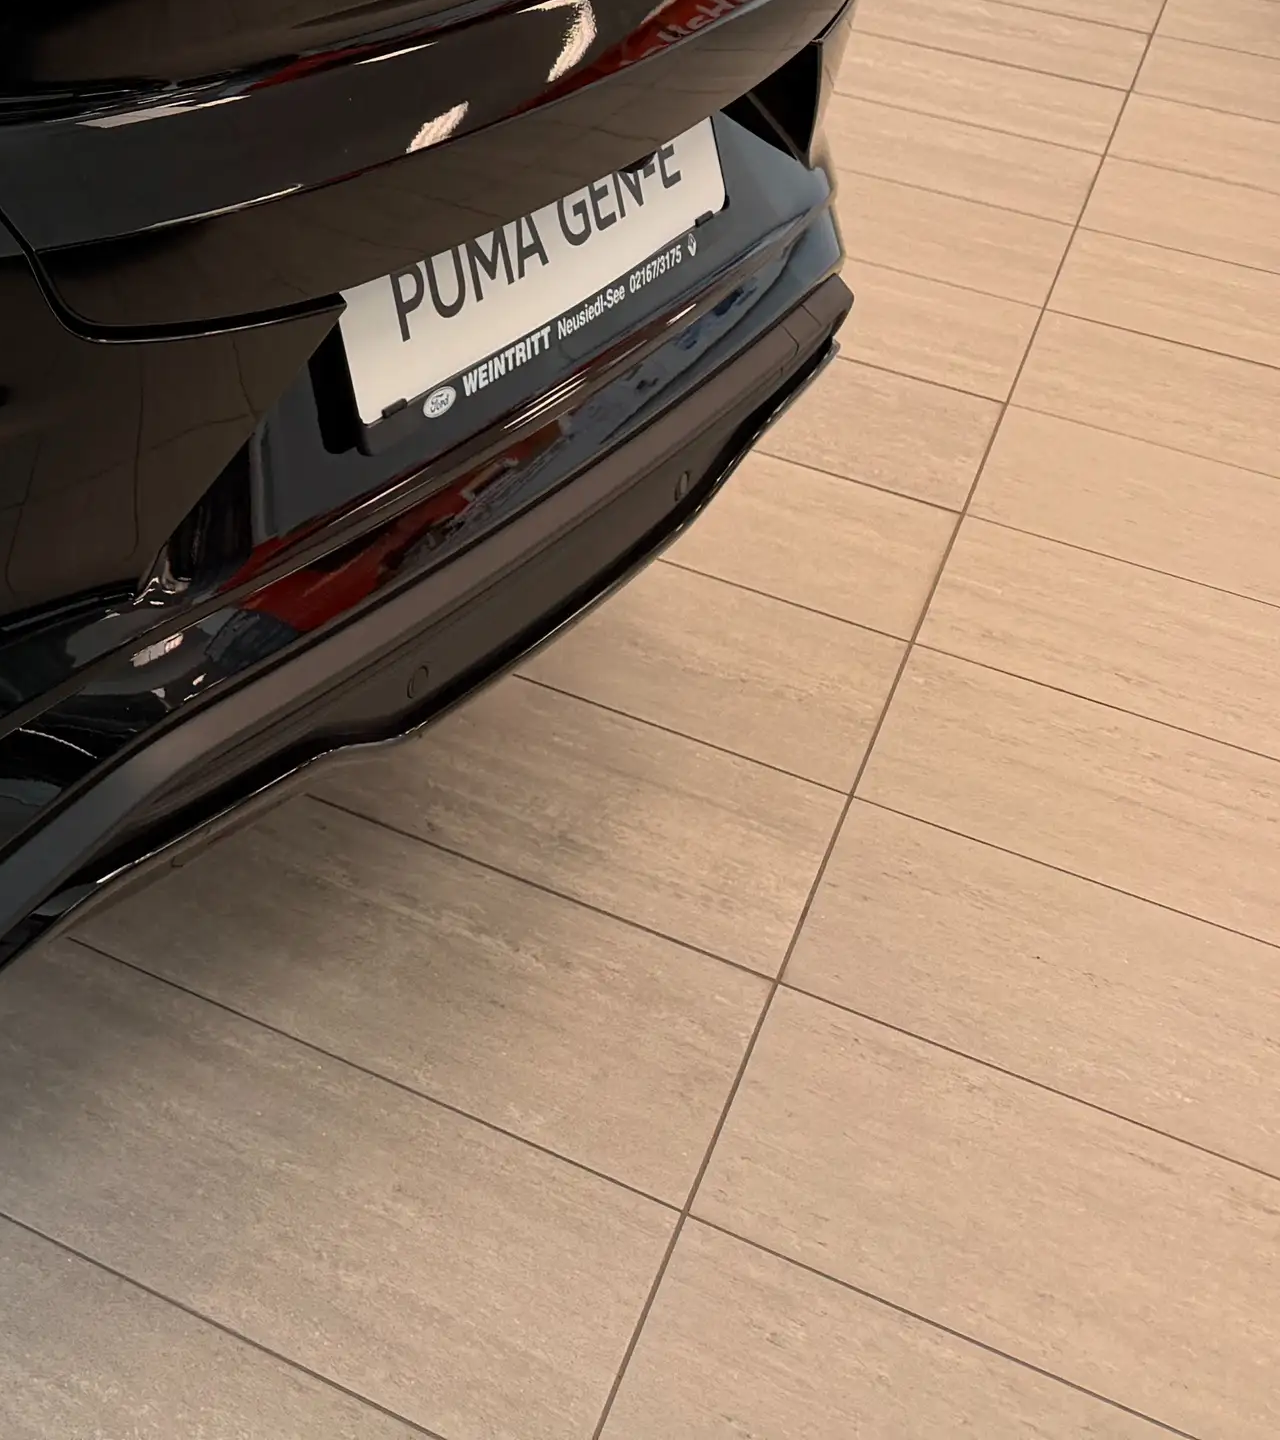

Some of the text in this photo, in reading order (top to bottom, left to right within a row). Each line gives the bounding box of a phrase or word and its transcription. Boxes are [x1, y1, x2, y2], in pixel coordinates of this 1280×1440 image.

[390, 143, 683, 343] PUMA GEN-E
[462, 327, 552, 397] WEINTRITT
[557, 285, 627, 341] Neusiedl-See
[628, 244, 683, 295] 02167/3175
